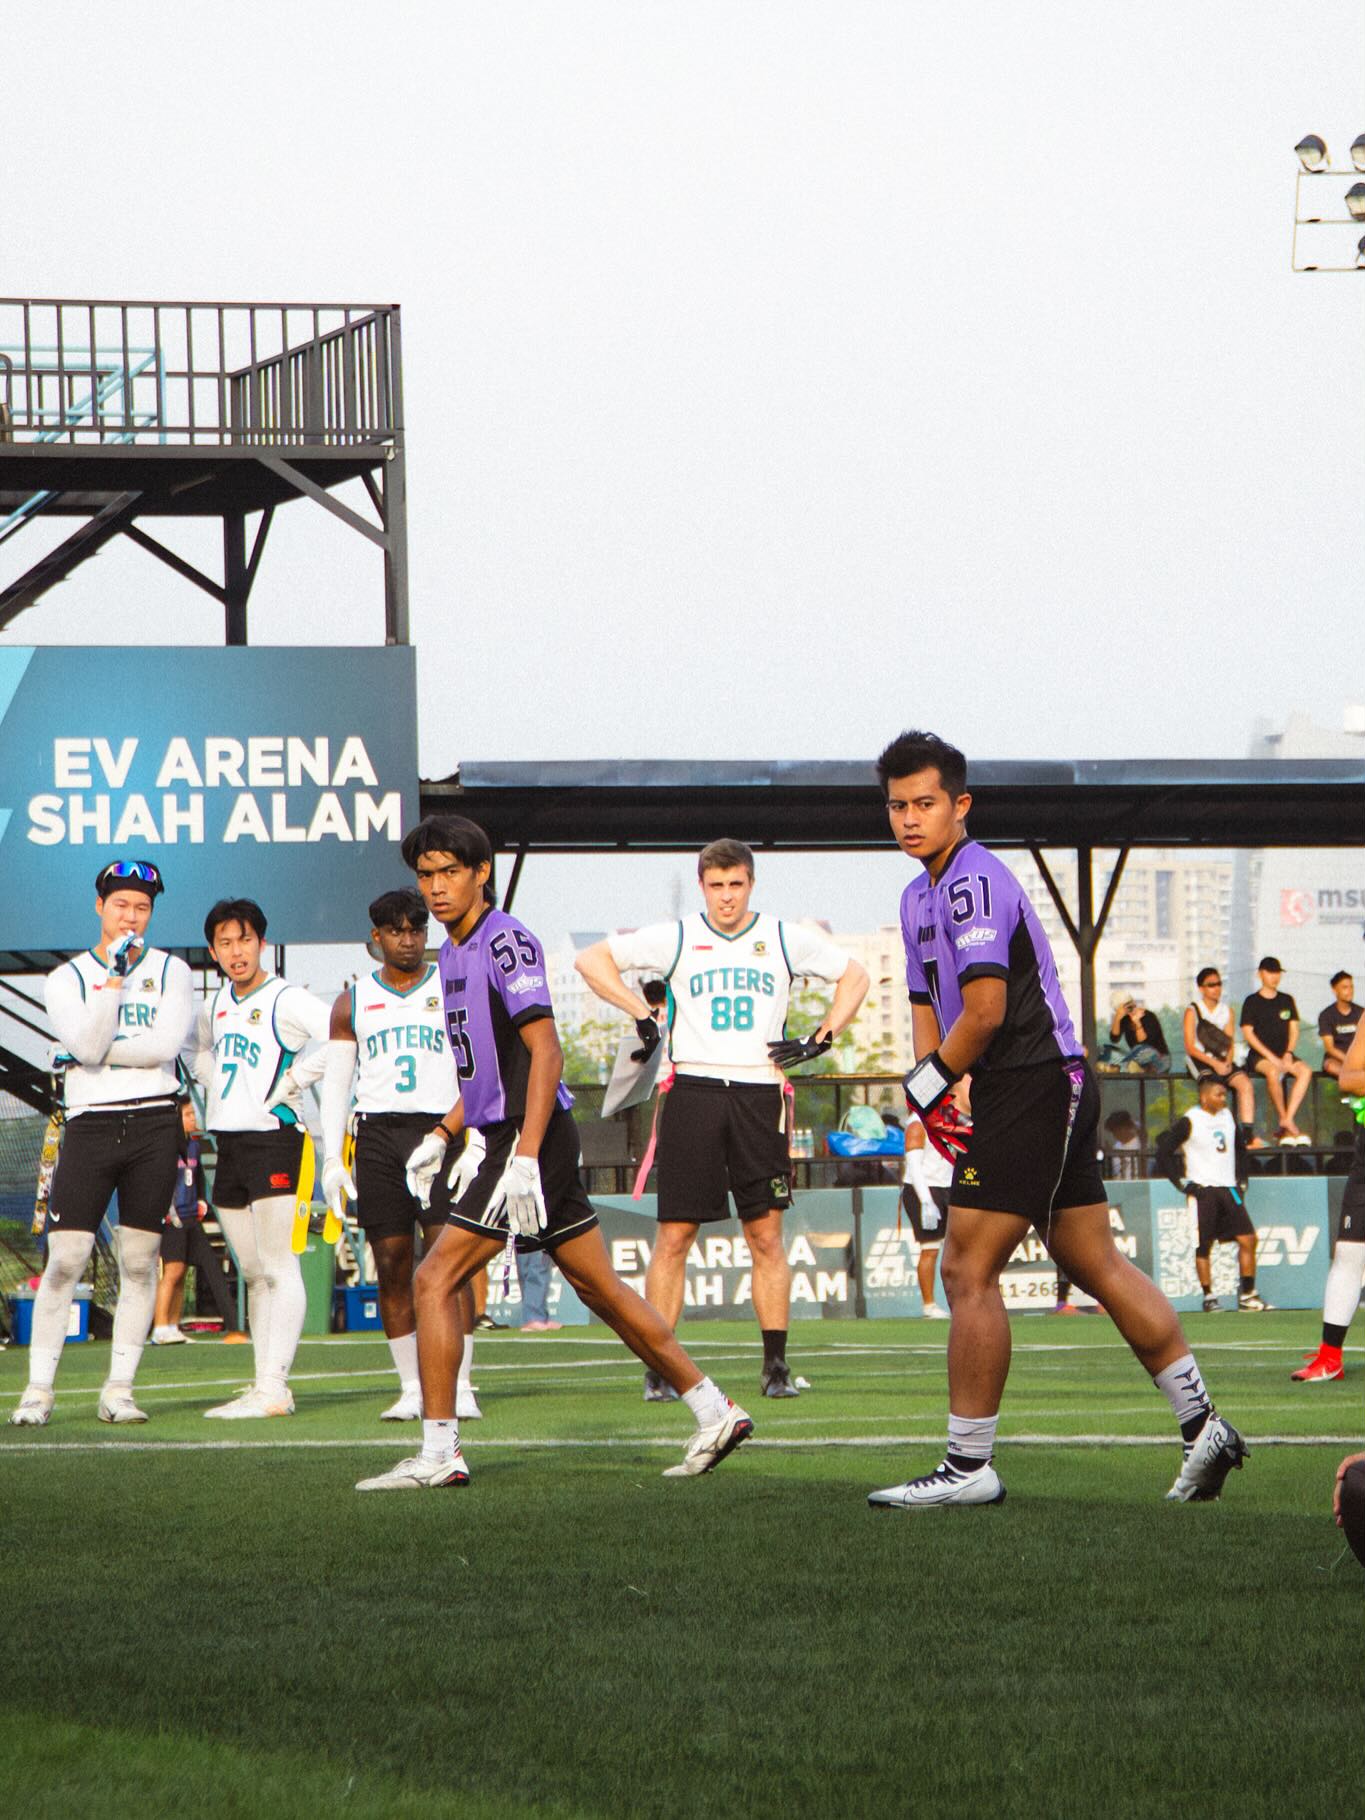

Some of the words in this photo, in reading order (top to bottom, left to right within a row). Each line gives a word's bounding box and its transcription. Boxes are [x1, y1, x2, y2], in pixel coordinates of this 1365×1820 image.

[54, 737, 139, 788] EV
[156, 736, 379, 787] ARENA
[27, 793, 204, 845] SHAH
[223, 792, 402, 842] ALAM
[947, 873, 992, 926] 51
[490, 929, 538, 976] 55
[690, 967, 775, 998] OTTERS
[711, 996, 754, 1031] 88
[367, 1024, 445, 1060] OTTERS
[221, 1063, 238, 1100] 7
[395, 1054, 417, 1093] 3
[1213, 1131, 1226, 1153] 3
[686, 1235, 817, 1268] AREA
[734, 1271, 847, 1304] AAM
